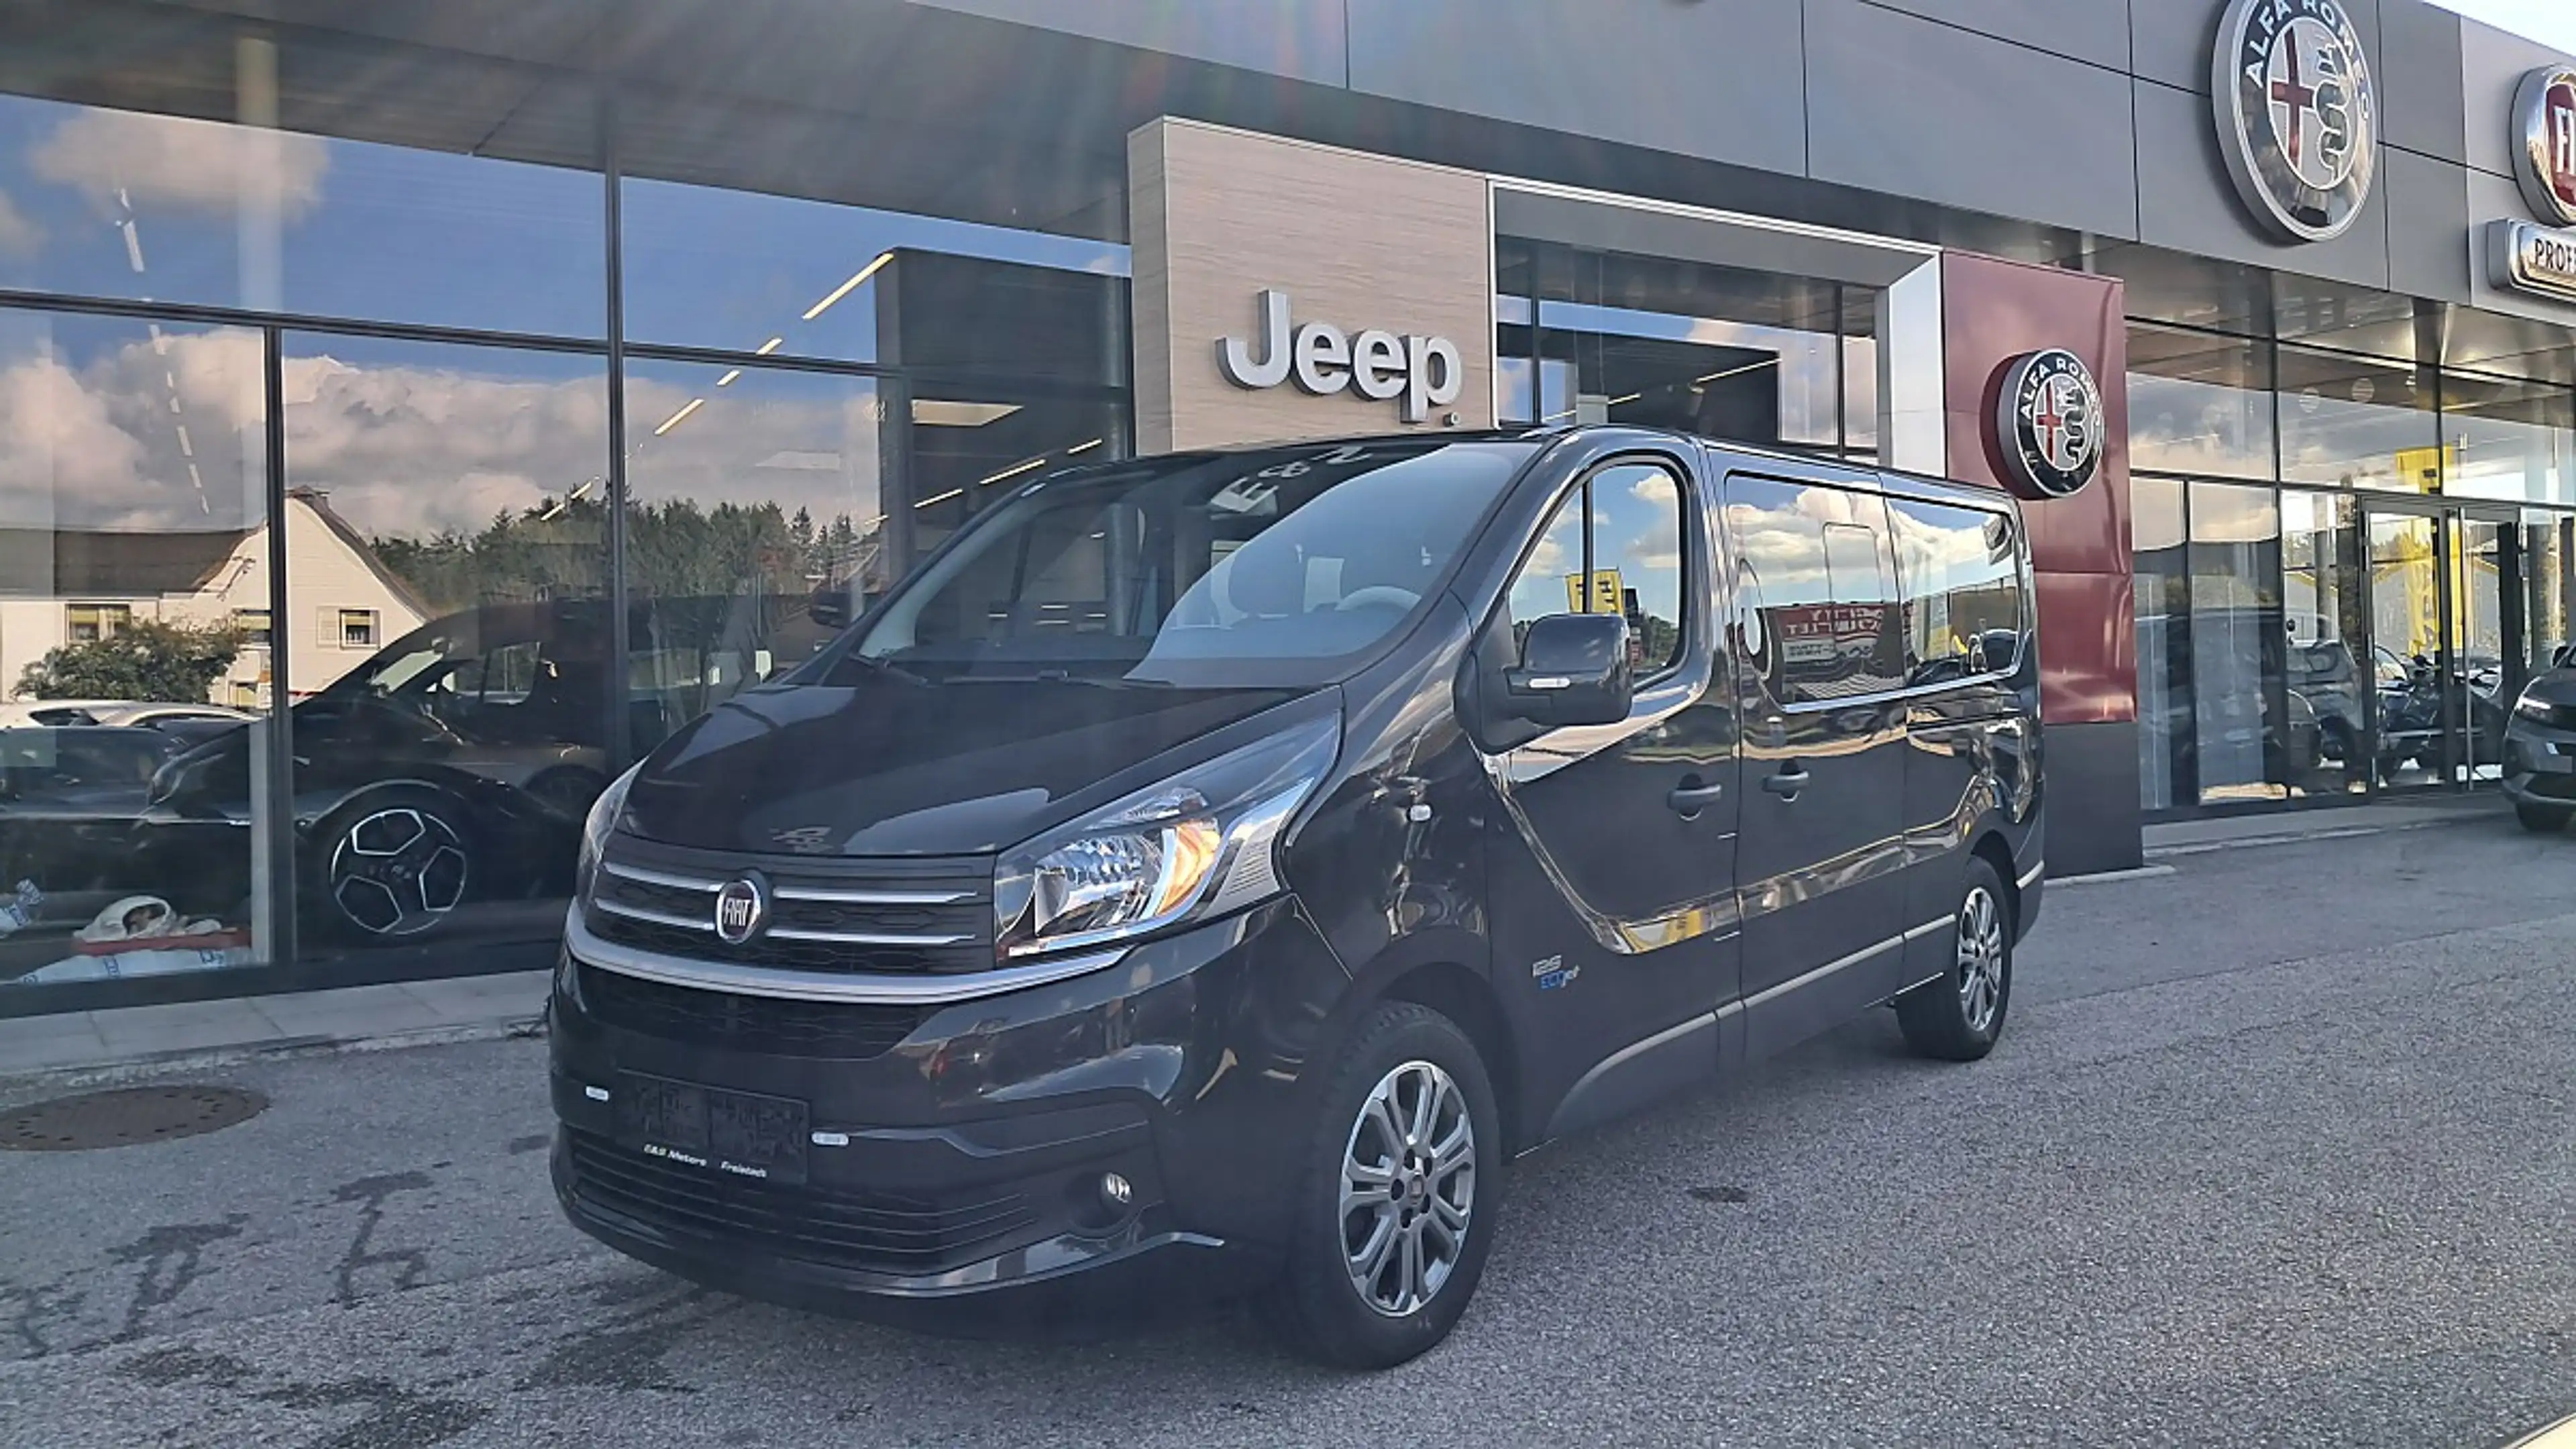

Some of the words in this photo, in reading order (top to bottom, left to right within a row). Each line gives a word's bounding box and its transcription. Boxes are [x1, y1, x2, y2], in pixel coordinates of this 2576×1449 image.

[2245, 0, 2292, 89] ALFA
[1216, 288, 1462, 423] Jeep
[2020, 364, 2051, 420] ALFA
[723, 897, 752, 926] FIAT
